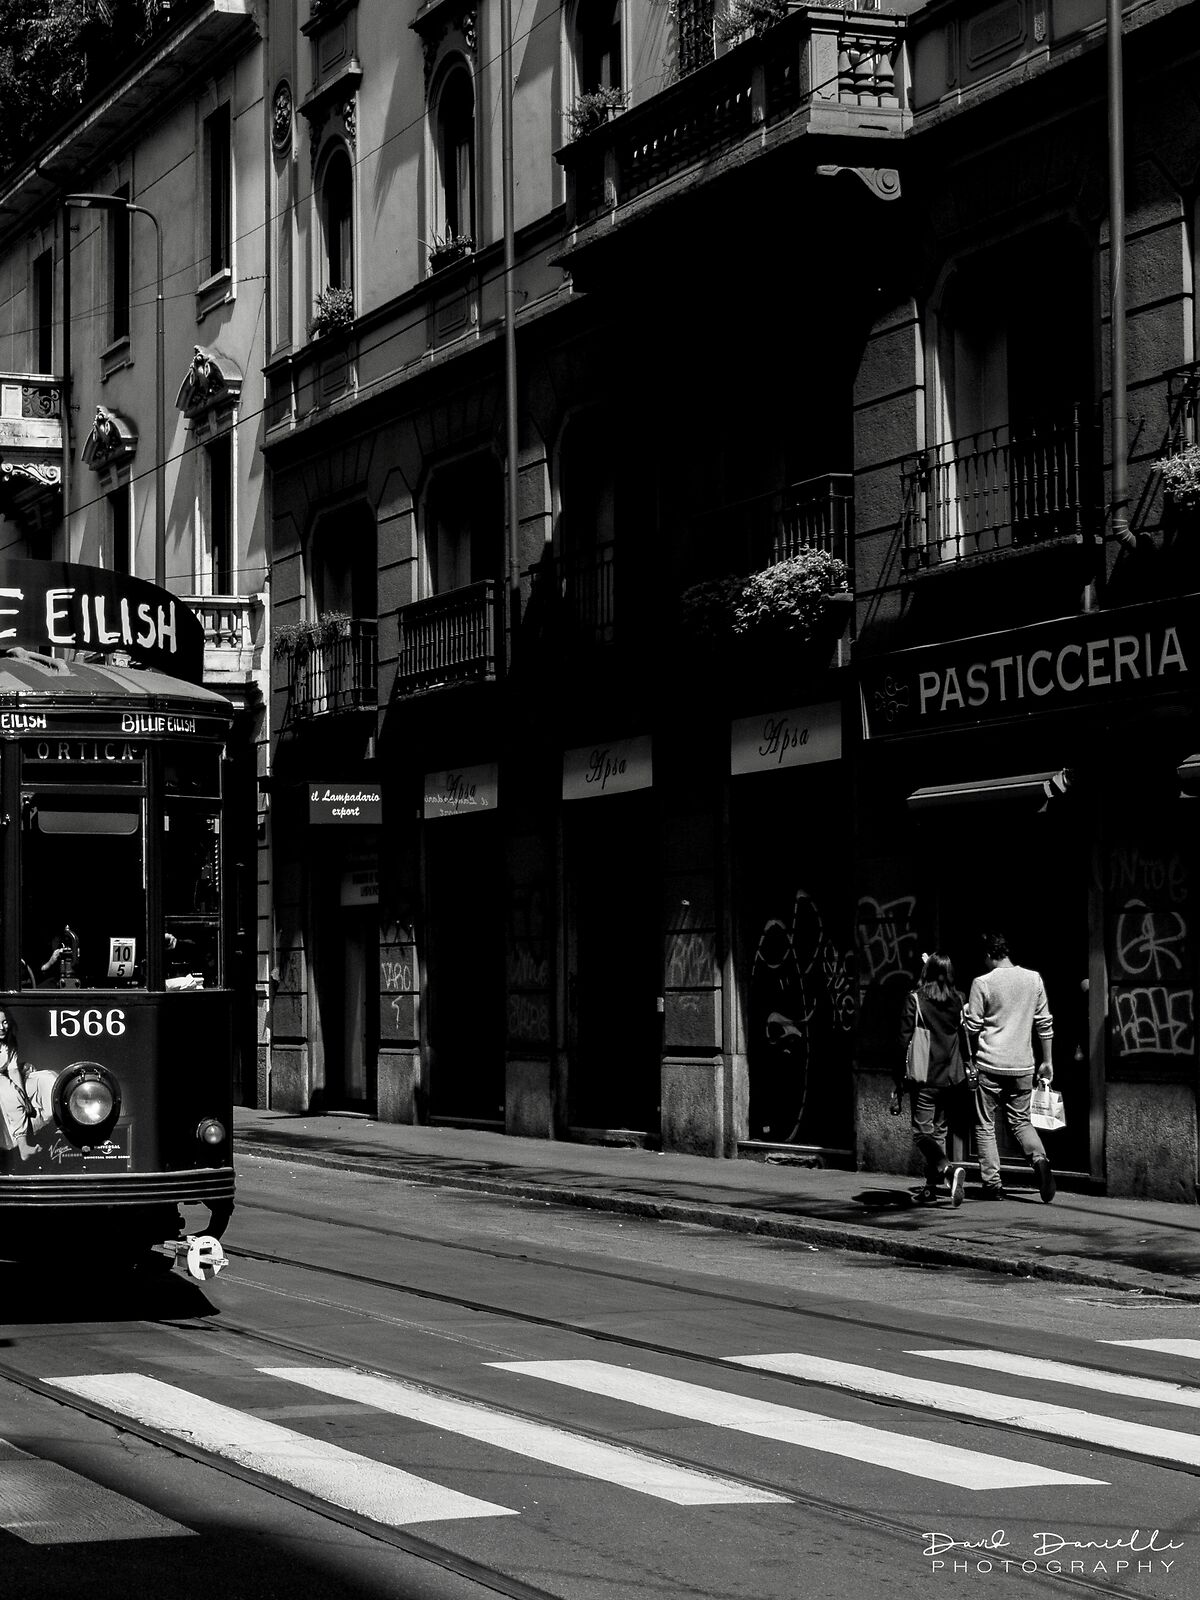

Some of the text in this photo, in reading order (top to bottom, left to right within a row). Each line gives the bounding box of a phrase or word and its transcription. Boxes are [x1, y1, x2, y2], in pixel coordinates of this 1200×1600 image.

[46, 587, 177, 653] EILISH
[918, 626, 1188, 715] PASTICCERIA
[0, 712, 47, 729] EILISH
[121, 713, 196, 733] BILLIE EILISH
[758, 718, 809, 764] Apsa
[37, 743, 133, 760] ORTICA
[585, 750, 627, 790] Apsa
[310, 789, 381, 804] il Lampadario
[442, 774, 476, 811] Apsa
[331, 806, 360, 819] export
[115, 946, 132, 962] 10
[116, 964, 126, 977] 5
[48, 1008, 127, 1037] 1566
